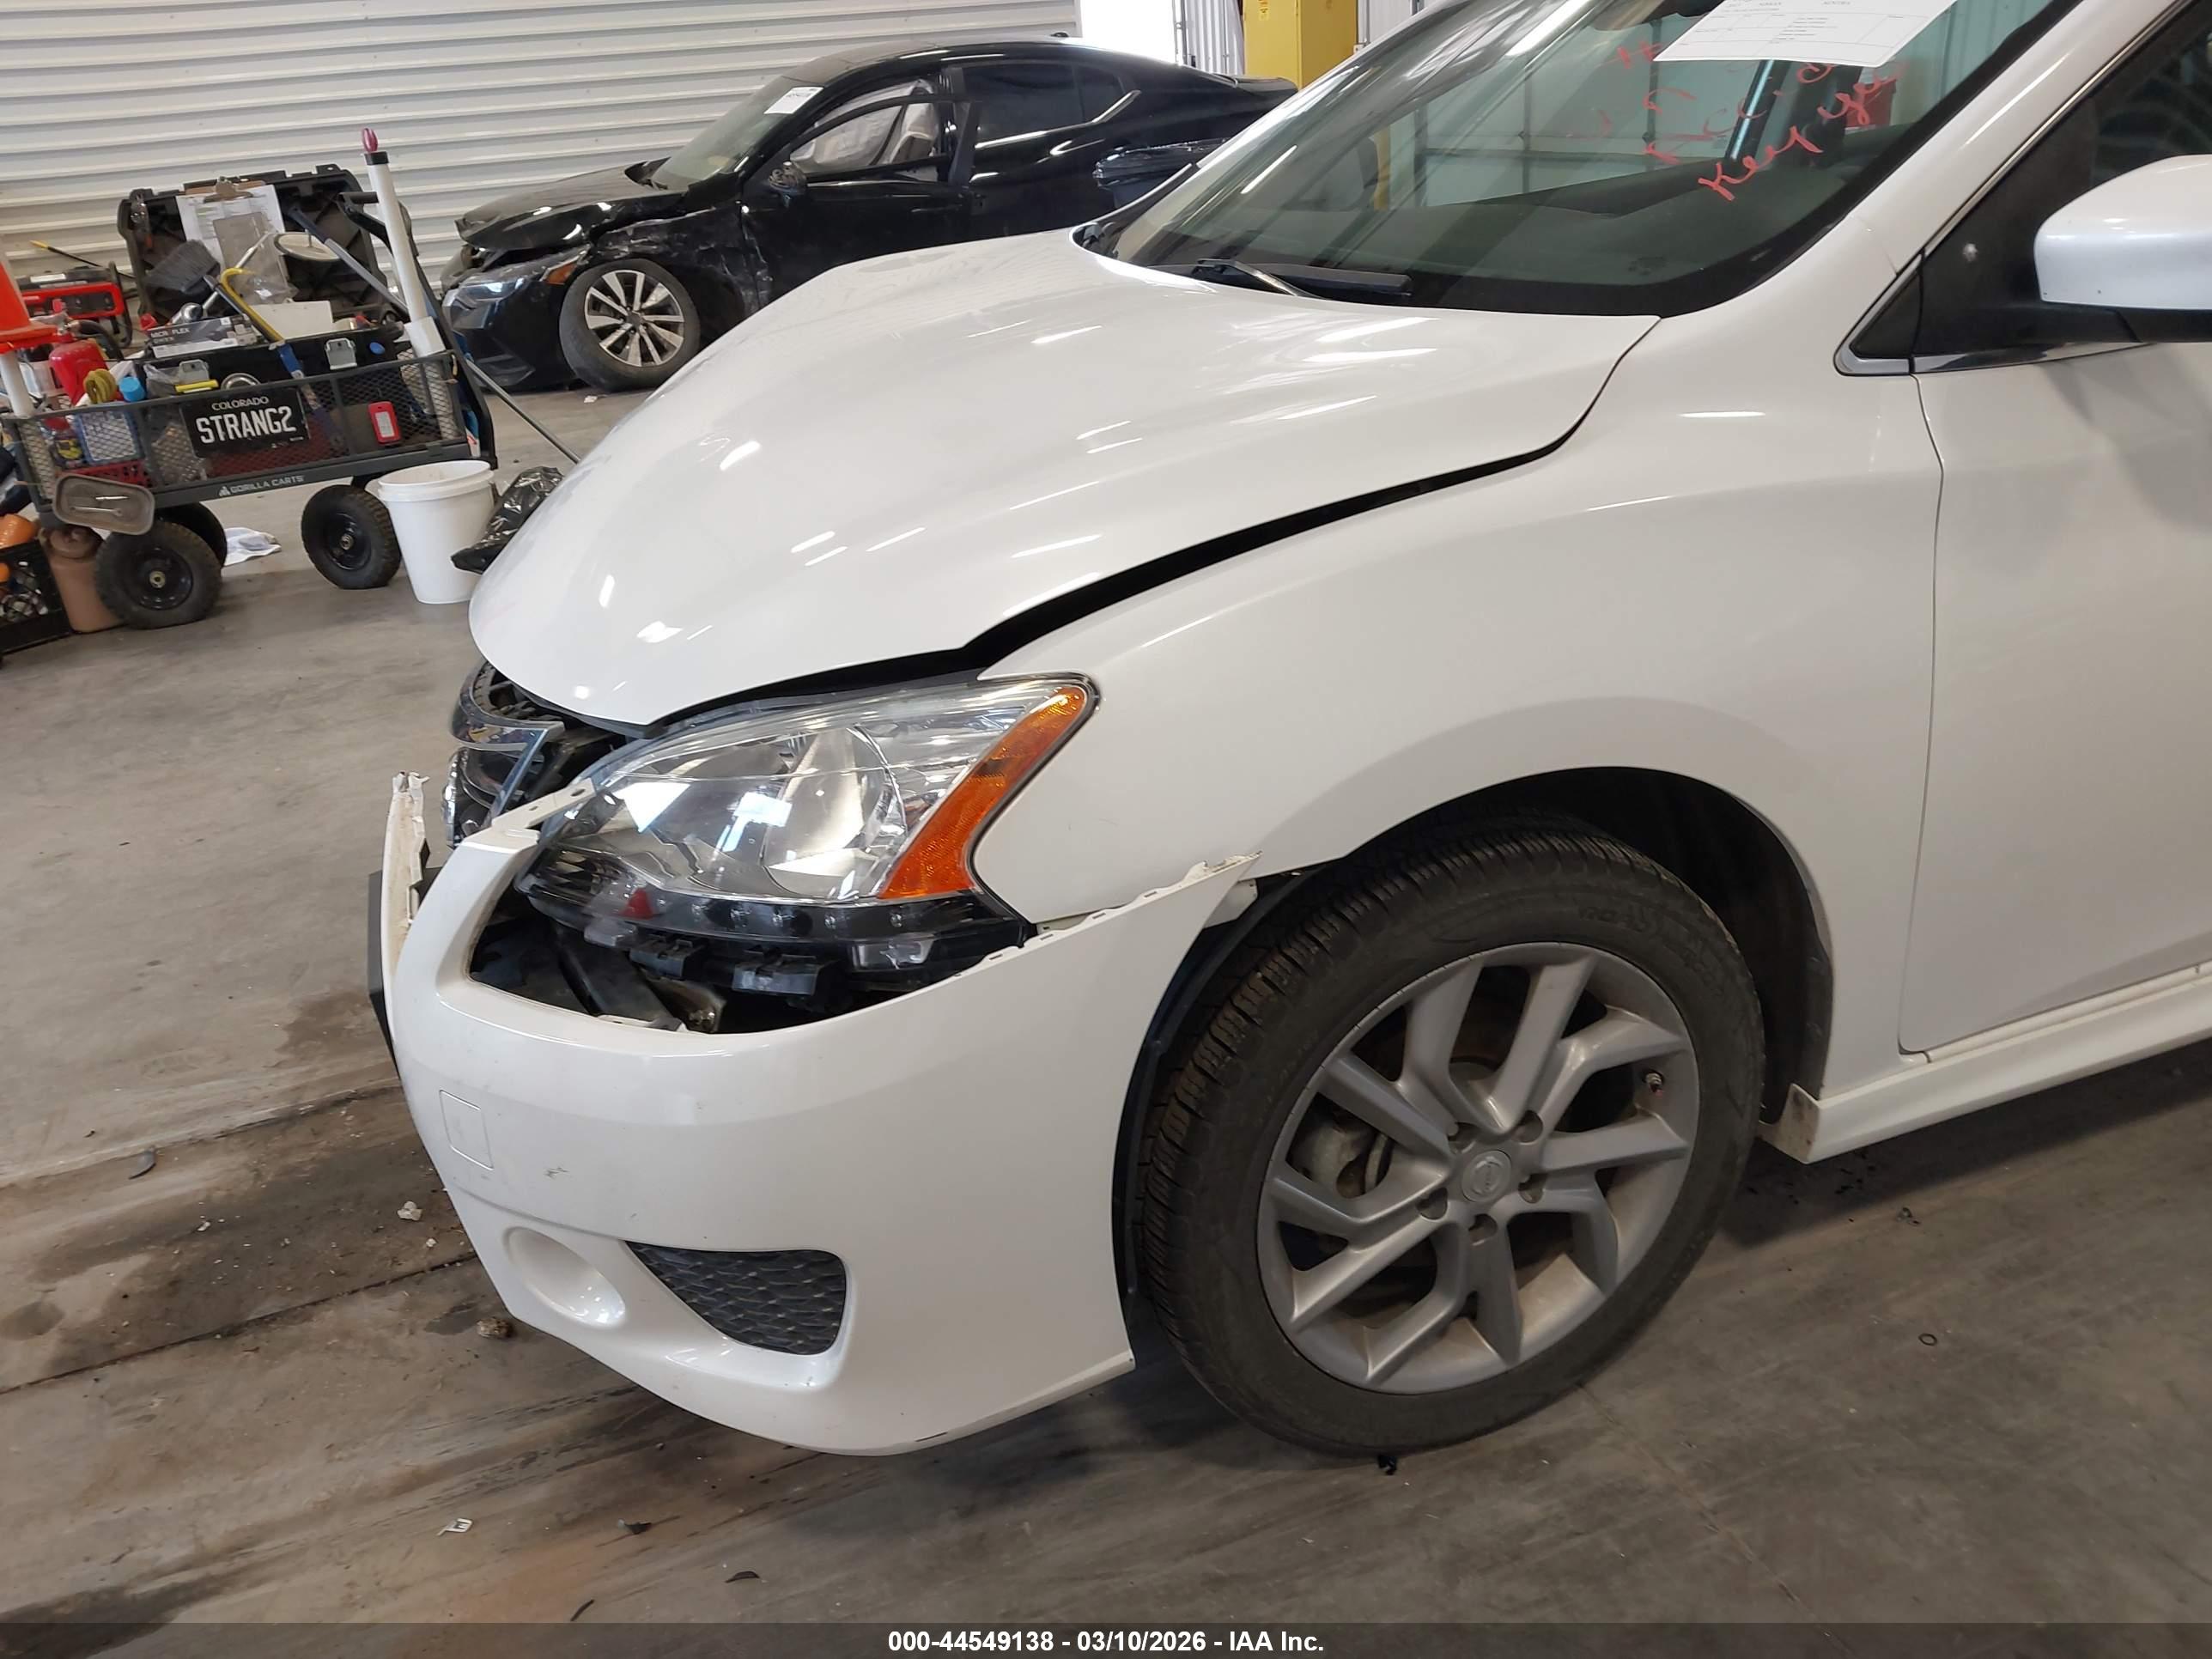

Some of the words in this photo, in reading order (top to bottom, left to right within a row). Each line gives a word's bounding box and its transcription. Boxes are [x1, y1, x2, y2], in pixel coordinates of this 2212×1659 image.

[211, 396, 270, 410] COLORADO
[196, 405, 296, 444] STRANG2
[230, 481, 270, 494] GORILLA
[271, 475, 305, 487] CARTS
